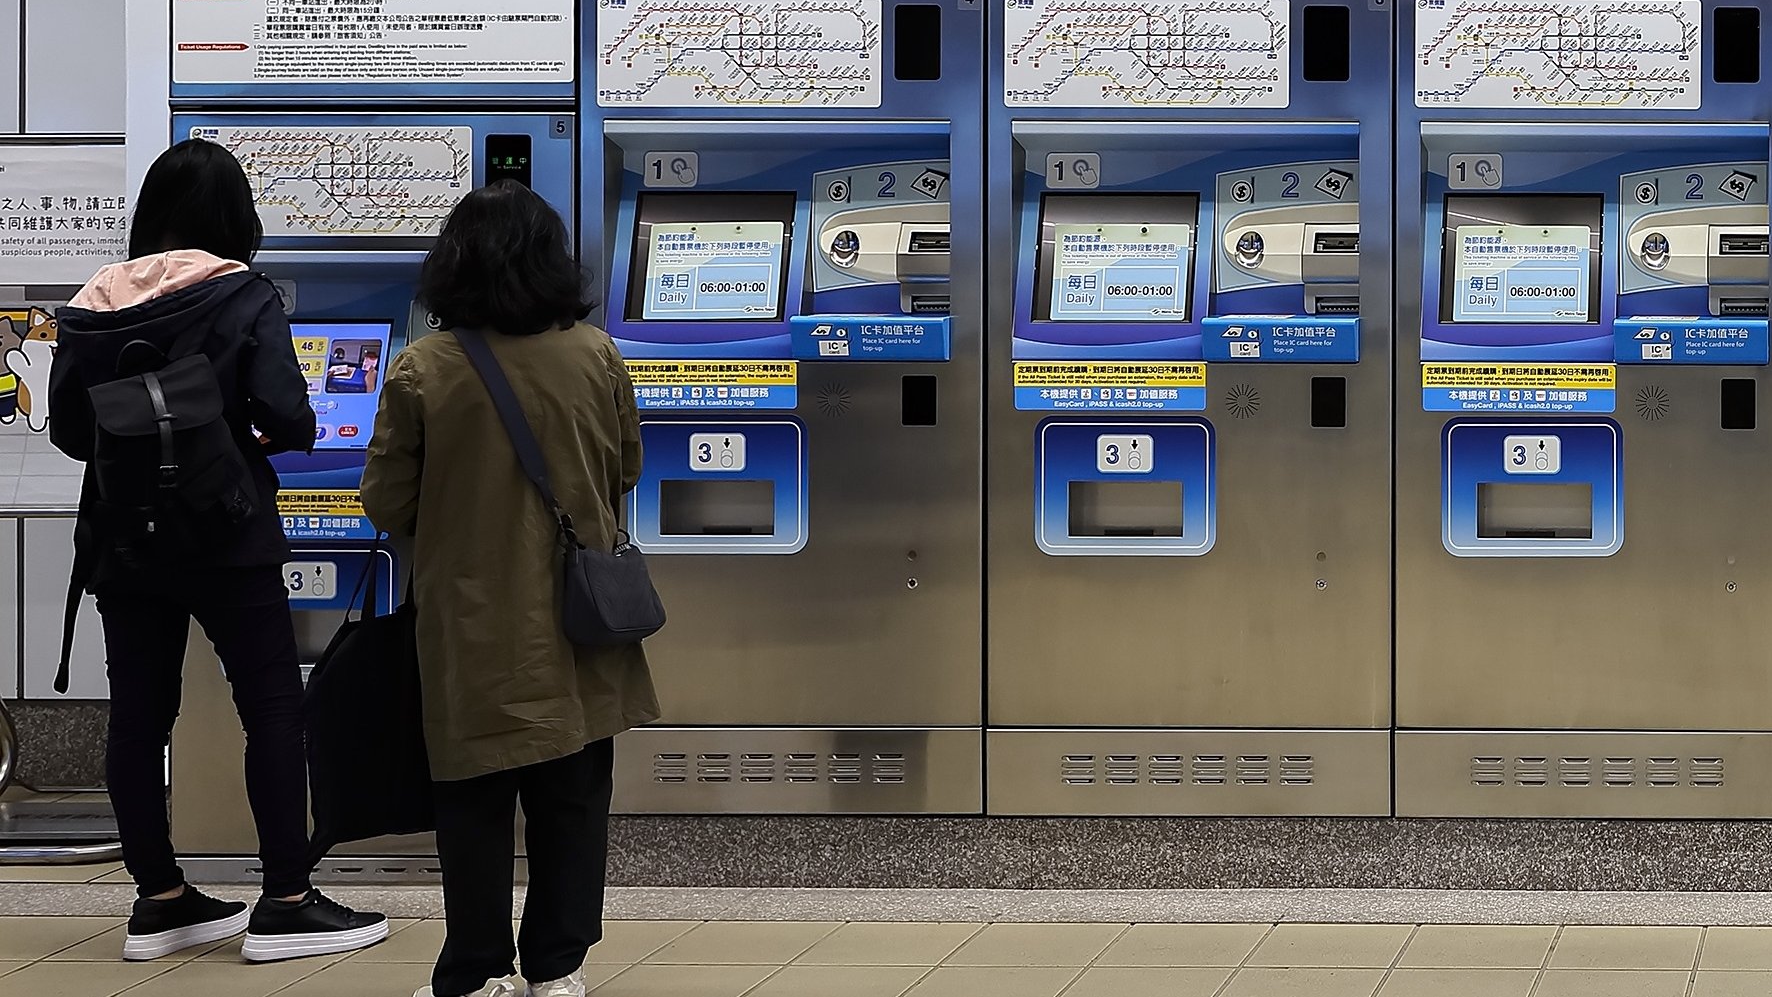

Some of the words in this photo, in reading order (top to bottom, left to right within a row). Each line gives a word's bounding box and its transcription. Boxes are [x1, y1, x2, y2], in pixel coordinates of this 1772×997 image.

[556, 120, 566, 134] 5
[651, 159, 662, 180] 1
[1053, 161, 1064, 181] 1
[1456, 161, 1467, 182] 1
[877, 171, 896, 198] 2
[1281, 172, 1300, 198] 2
[1685, 173, 1704, 200] 2
[1, 237, 24, 246] safety
[661, 274, 689, 288] 每日
[700, 283, 765, 292] 06:00-01:00
[1068, 275, 1096, 289] 每日
[1470, 277, 1498, 291] 每日
[1108, 286, 1172, 295] 06:00-01:00
[1510, 287, 1575, 297] 06:00-01:00
[659, 293, 687, 304] Daily
[1067, 294, 1094, 305] Daily
[1469, 295, 1497, 306] Daily
[861, 325, 924, 336] IC卡加值平台
[1272, 327, 1336, 337] IC卡加值平台
[1685, 328, 1748, 339] IC卡加值平台
[302, 342, 313, 350] 46
[1040, 389, 1078, 399] 本機提供
[1114, 390, 1124, 399] 及
[1139, 390, 1178, 399] 加值服務
[1449, 391, 1487, 400] 本機提供
[1523, 391, 1533, 400] 及
[1549, 392, 1587, 401] 加值服務
[697, 442, 713, 464] 3
[1105, 444, 1120, 466] 3
[1512, 445, 1527, 466] 3
[289, 570, 304, 592] 3
